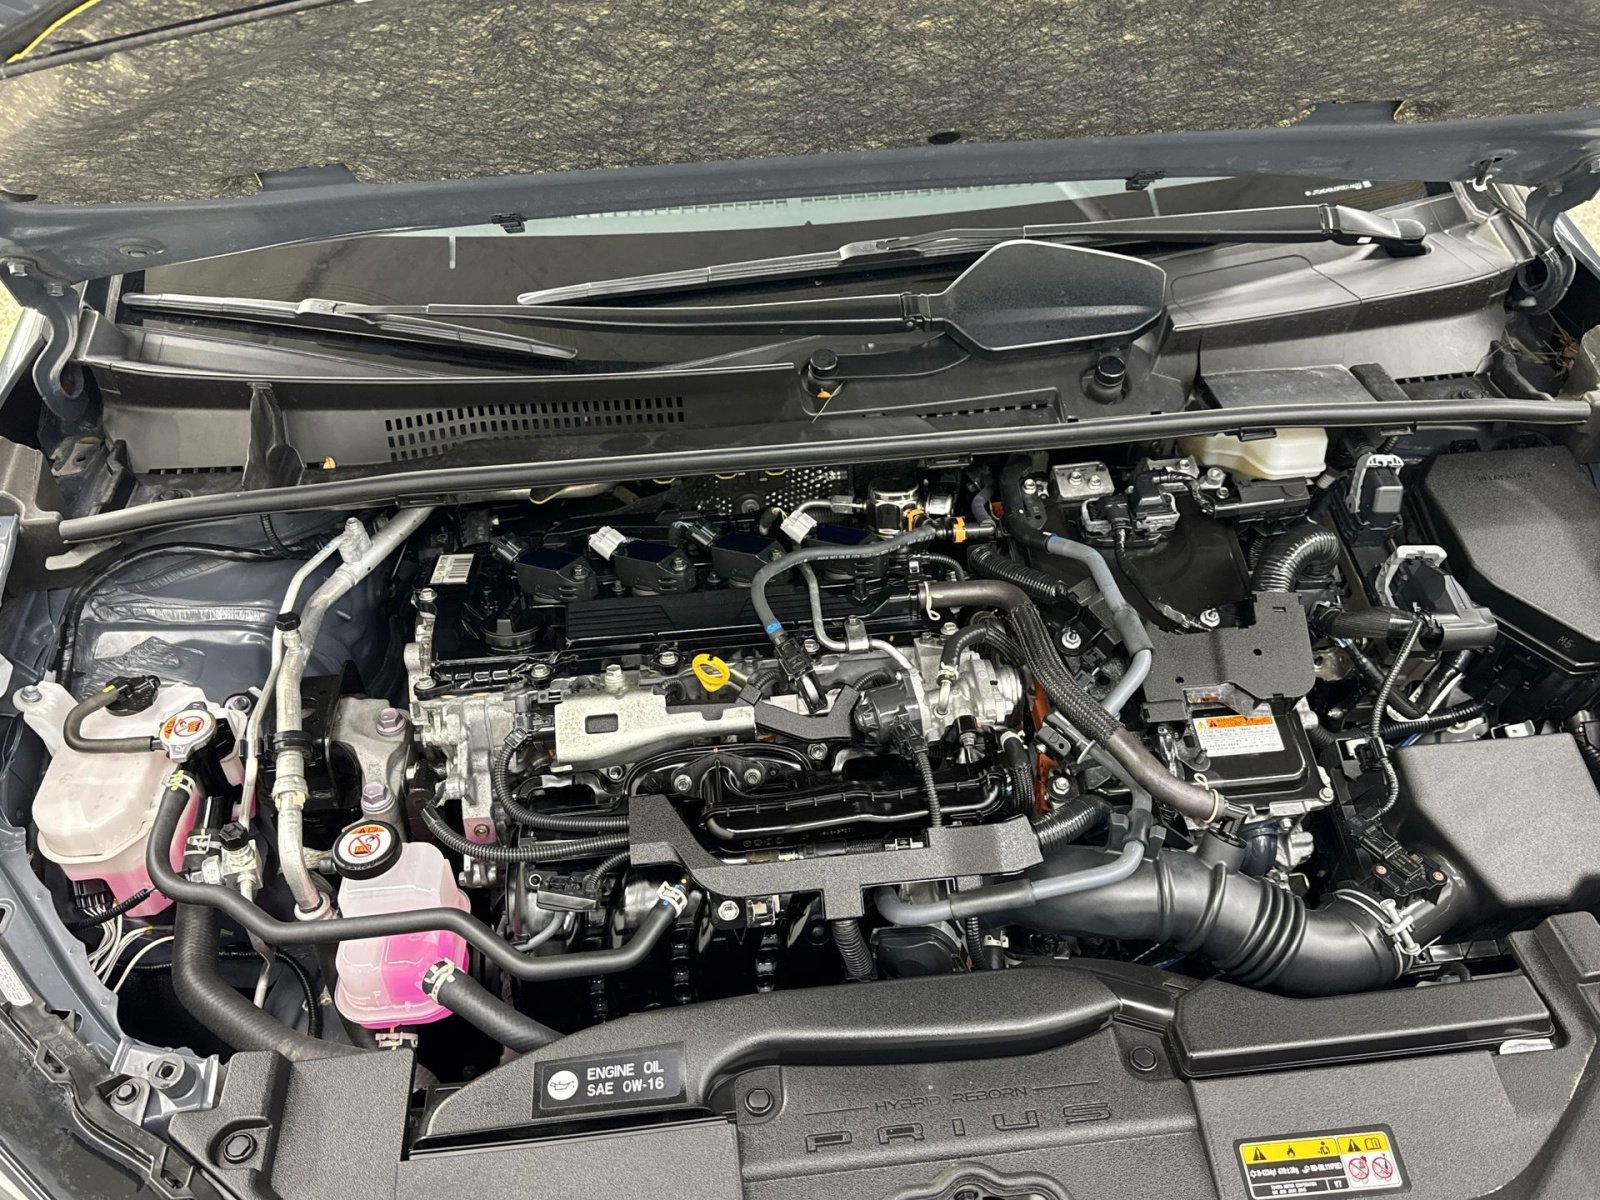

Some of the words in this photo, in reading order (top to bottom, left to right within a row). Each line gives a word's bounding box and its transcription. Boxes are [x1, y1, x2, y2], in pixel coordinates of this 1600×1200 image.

[587, 1063, 635, 1081] ENGINE
[643, 1060, 665, 1074] OIL
[587, 1081, 614, 1097] SAE
[622, 1076, 665, 1093] 0W-16
[874, 1095, 942, 1112] HYBRID
[951, 1086, 1028, 1103] REBORN
[805, 1101, 1112, 1152] PRIUS
